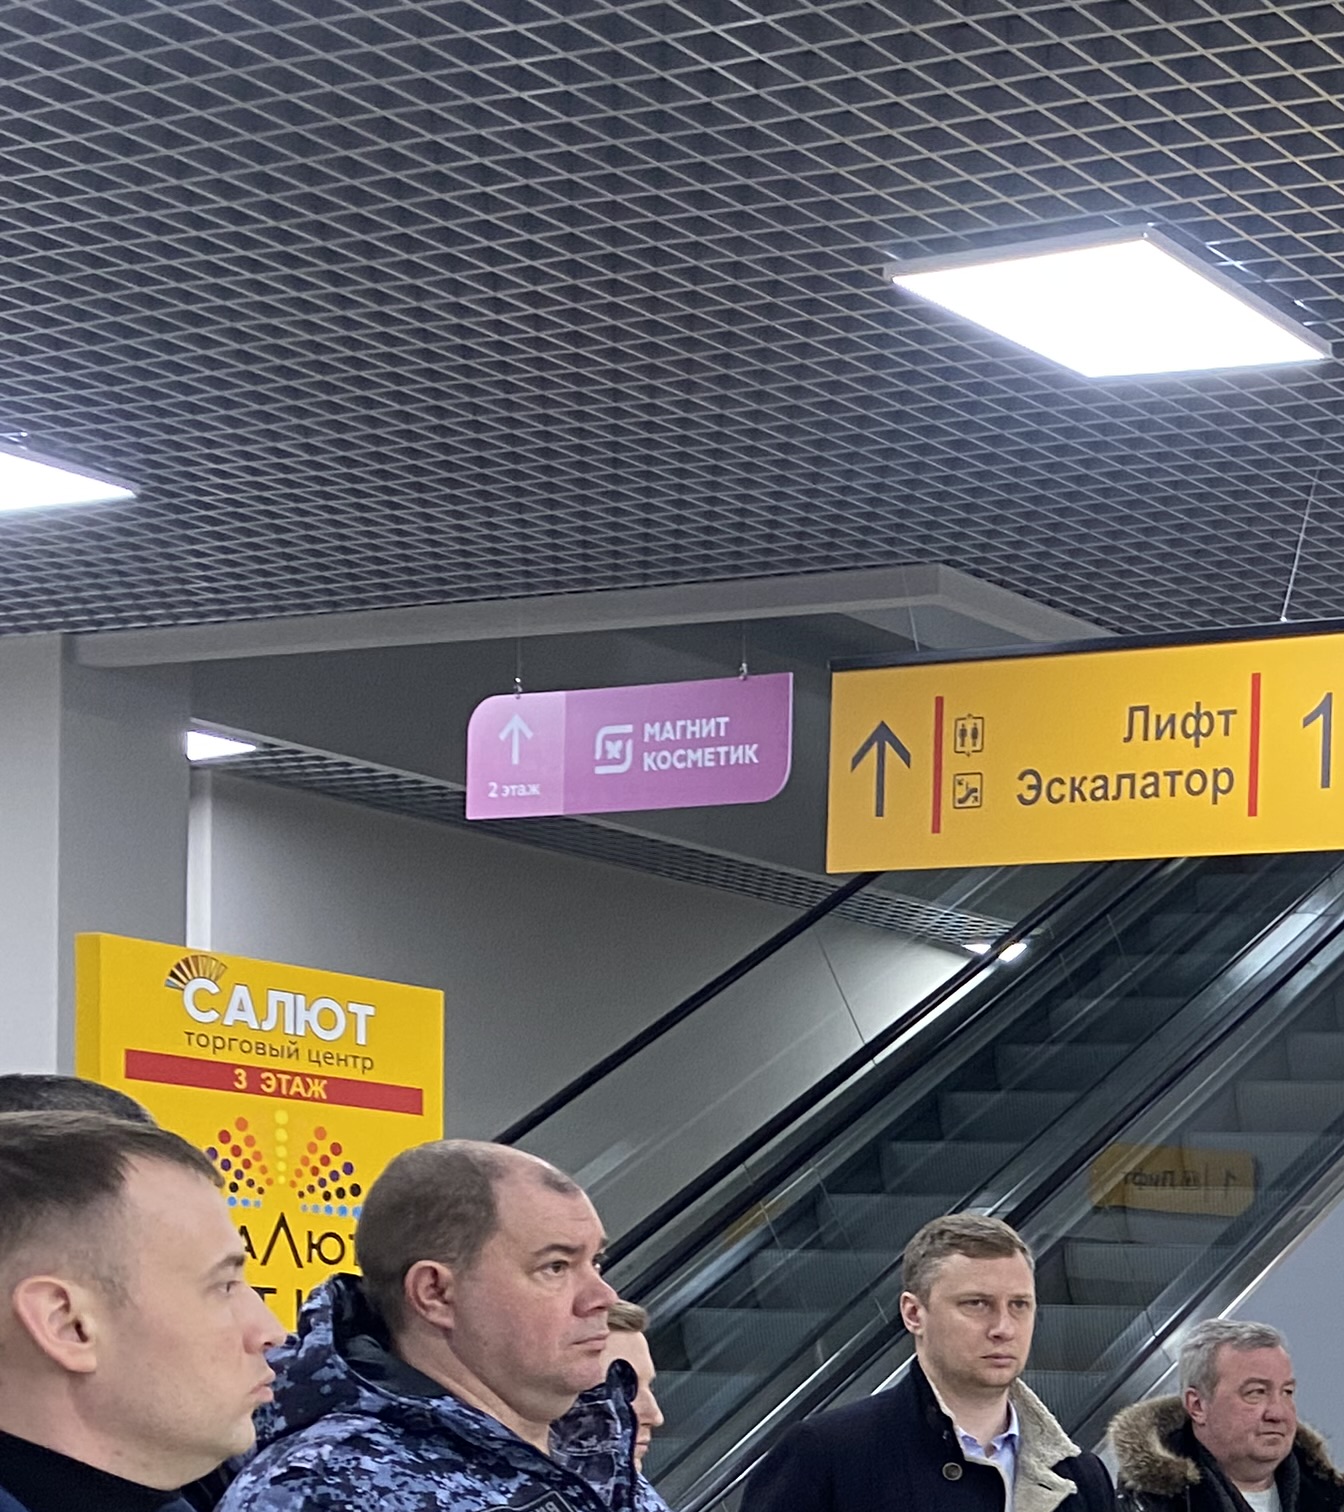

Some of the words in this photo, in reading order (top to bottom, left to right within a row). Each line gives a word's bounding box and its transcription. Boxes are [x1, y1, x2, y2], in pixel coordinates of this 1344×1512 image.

[643, 717, 730, 742] МАГНИТ
[1123, 702, 1237, 748] Лифт
[1302, 691, 1333, 789] 1
[643, 744, 759, 771] КОСМЕТИК
[488, 782, 498, 797] 2
[502, 782, 541, 798] этаж
[1016, 763, 1235, 806] Эскалатор
[182, 977, 375, 1046] САЛЮТ
[184, 1030, 300, 1060] торговый
[307, 1050, 374, 1073] центр
[233, 1068, 248, 1089] 3
[260, 1072, 328, 1099] ЭТАЖ
